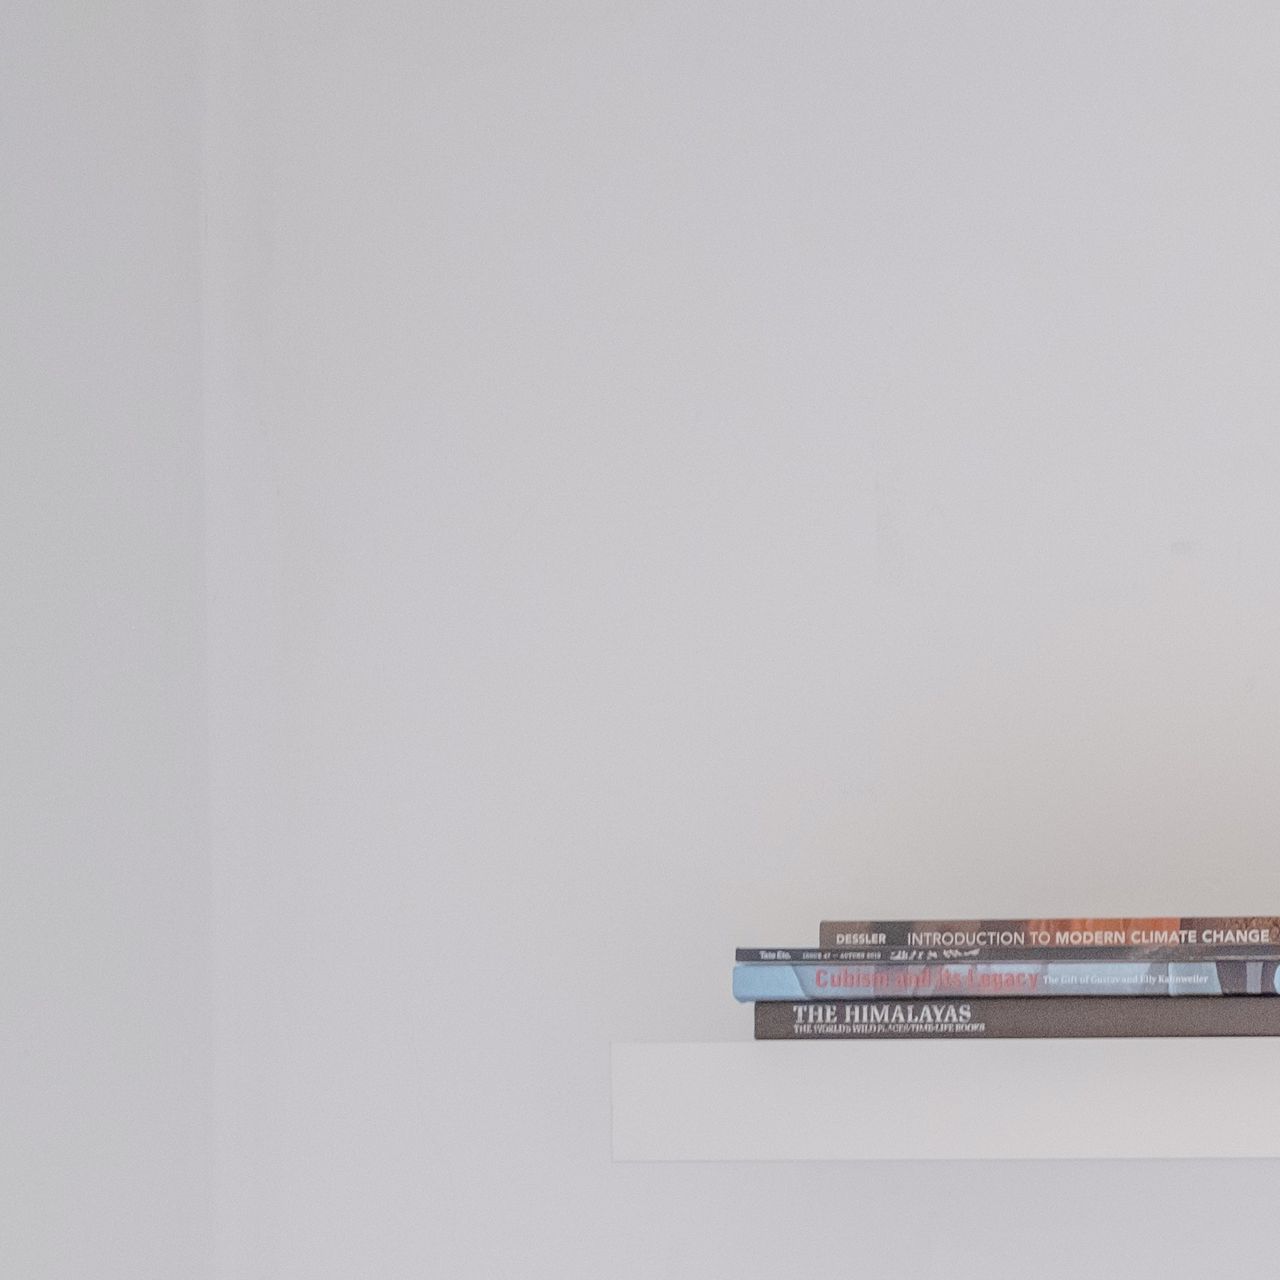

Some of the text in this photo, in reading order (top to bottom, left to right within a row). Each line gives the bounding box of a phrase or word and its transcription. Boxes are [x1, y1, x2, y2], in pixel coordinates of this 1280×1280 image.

[836, 932, 887, 945] DESSLER
[907, 928, 1270, 946] INTRODUCTION TO MODERN CLIMATE CHANGE
[815, 966, 889, 989] Cubism
[895, 966, 931, 988] and
[968, 967, 1039, 992] Legacy
[792, 1004, 972, 1024] THE HIMALAYAS
